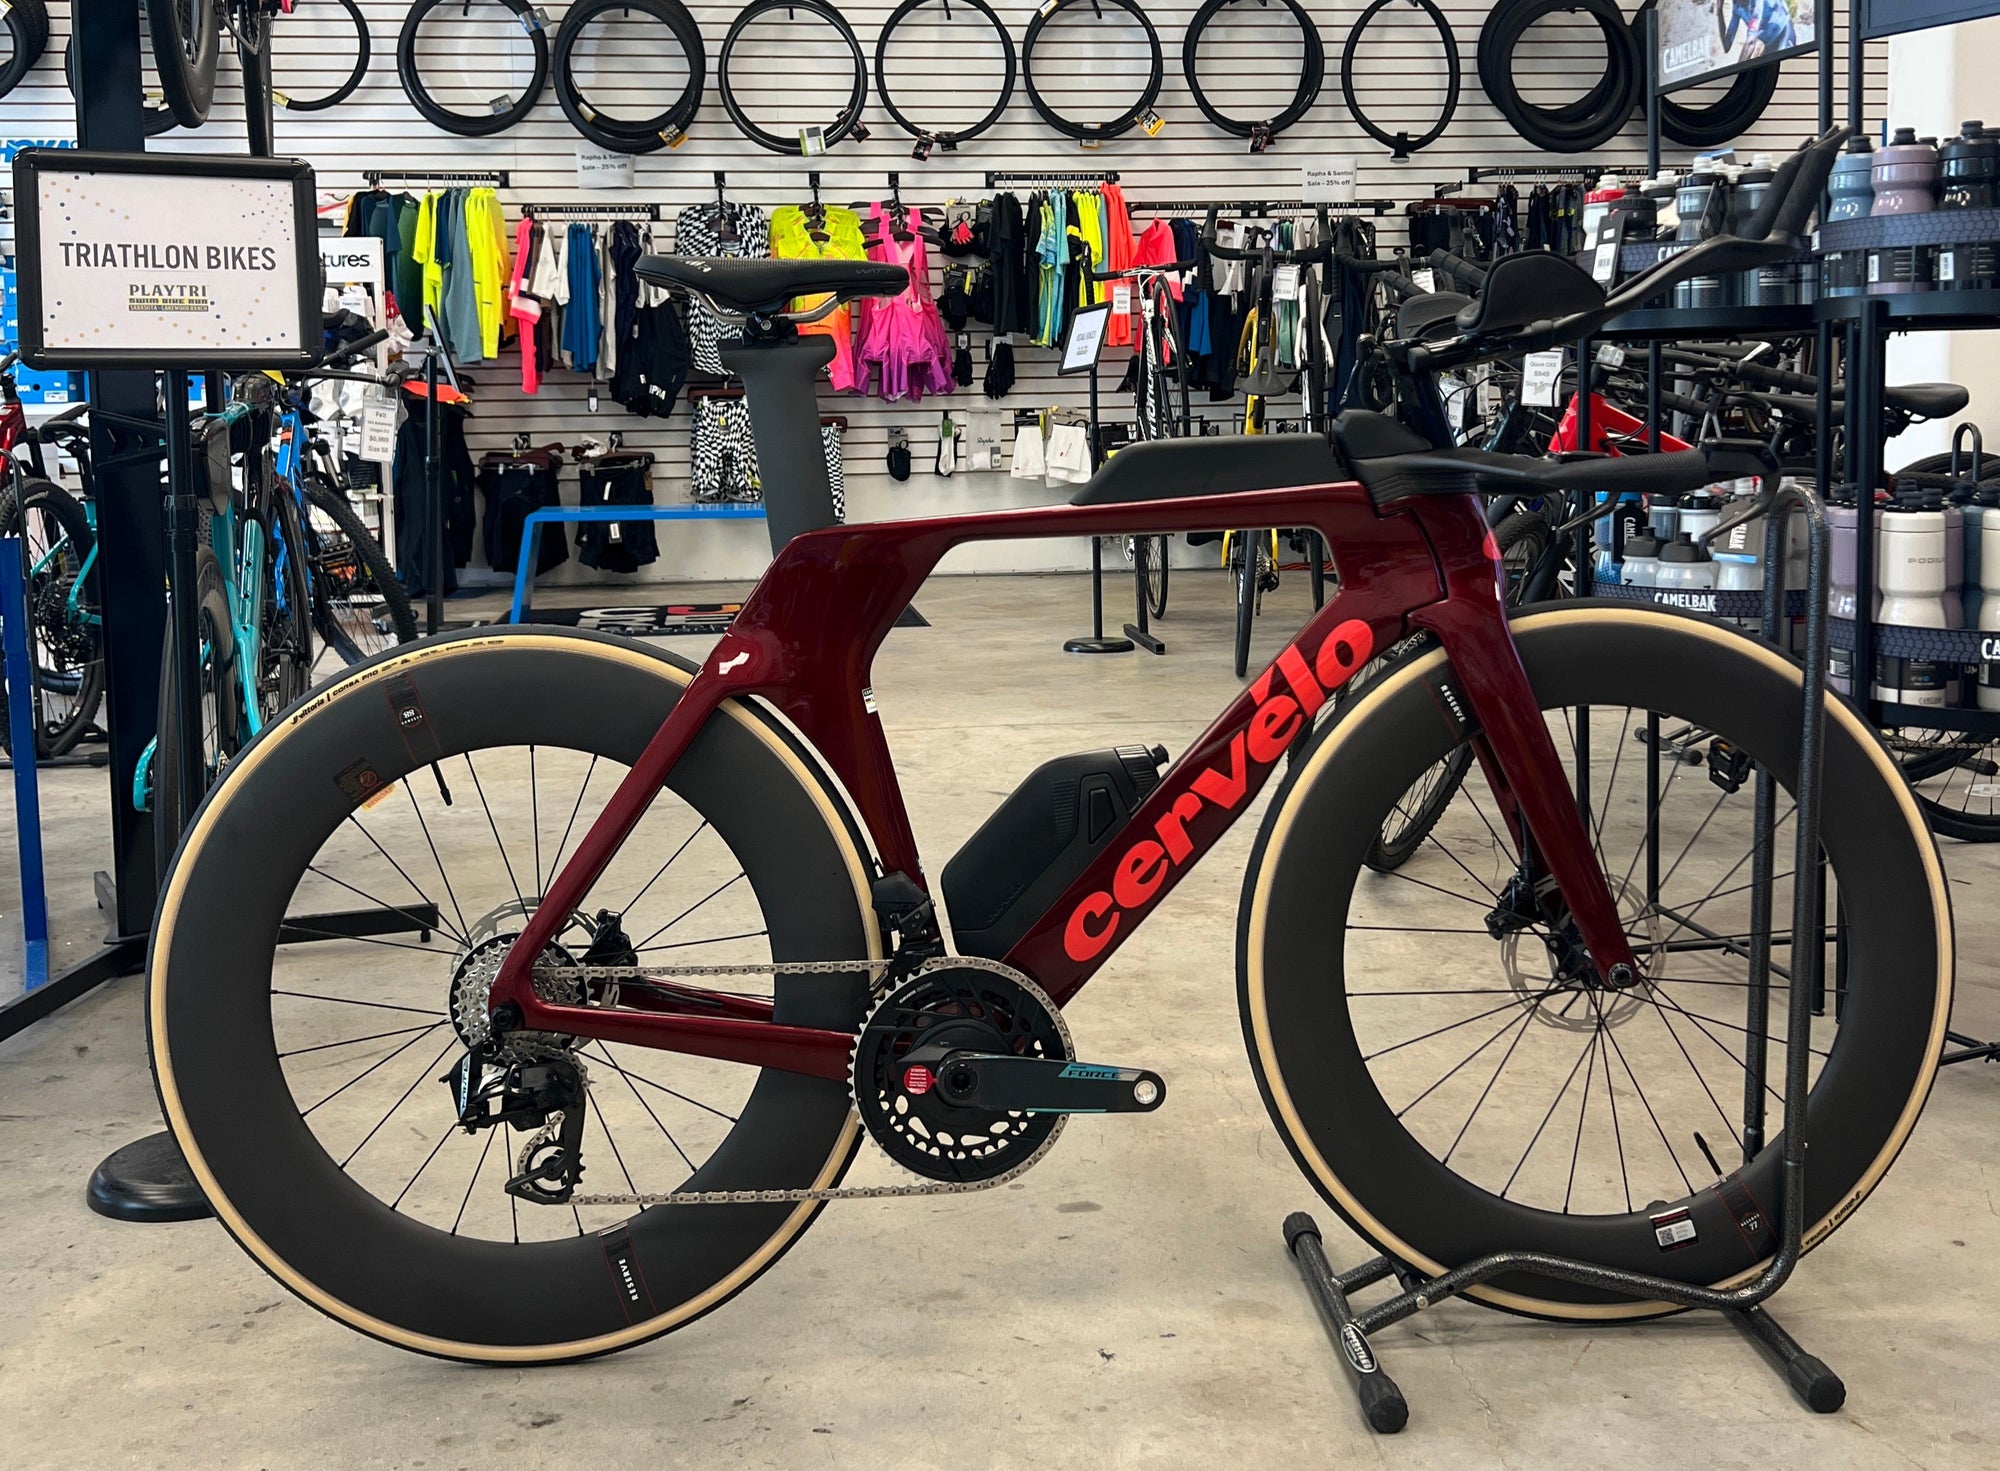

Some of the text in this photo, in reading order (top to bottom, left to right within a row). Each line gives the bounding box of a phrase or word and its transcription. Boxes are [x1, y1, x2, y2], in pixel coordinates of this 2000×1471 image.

[59, 242, 276, 271] TRIATHLON BIKES
[128, 284, 207, 297] PLAYTRI
[1654, 592, 1716, 612] CAMELBAK
[1981, 638, 2000, 660] CA
[361, 669, 379, 681] PRO
[1440, 684, 1467, 723] RESERVE
[1063, 618, 1375, 962] cervélo
[1067, 1069, 1122, 1079] FORCE
[618, 1258, 640, 1302] RESERVE
